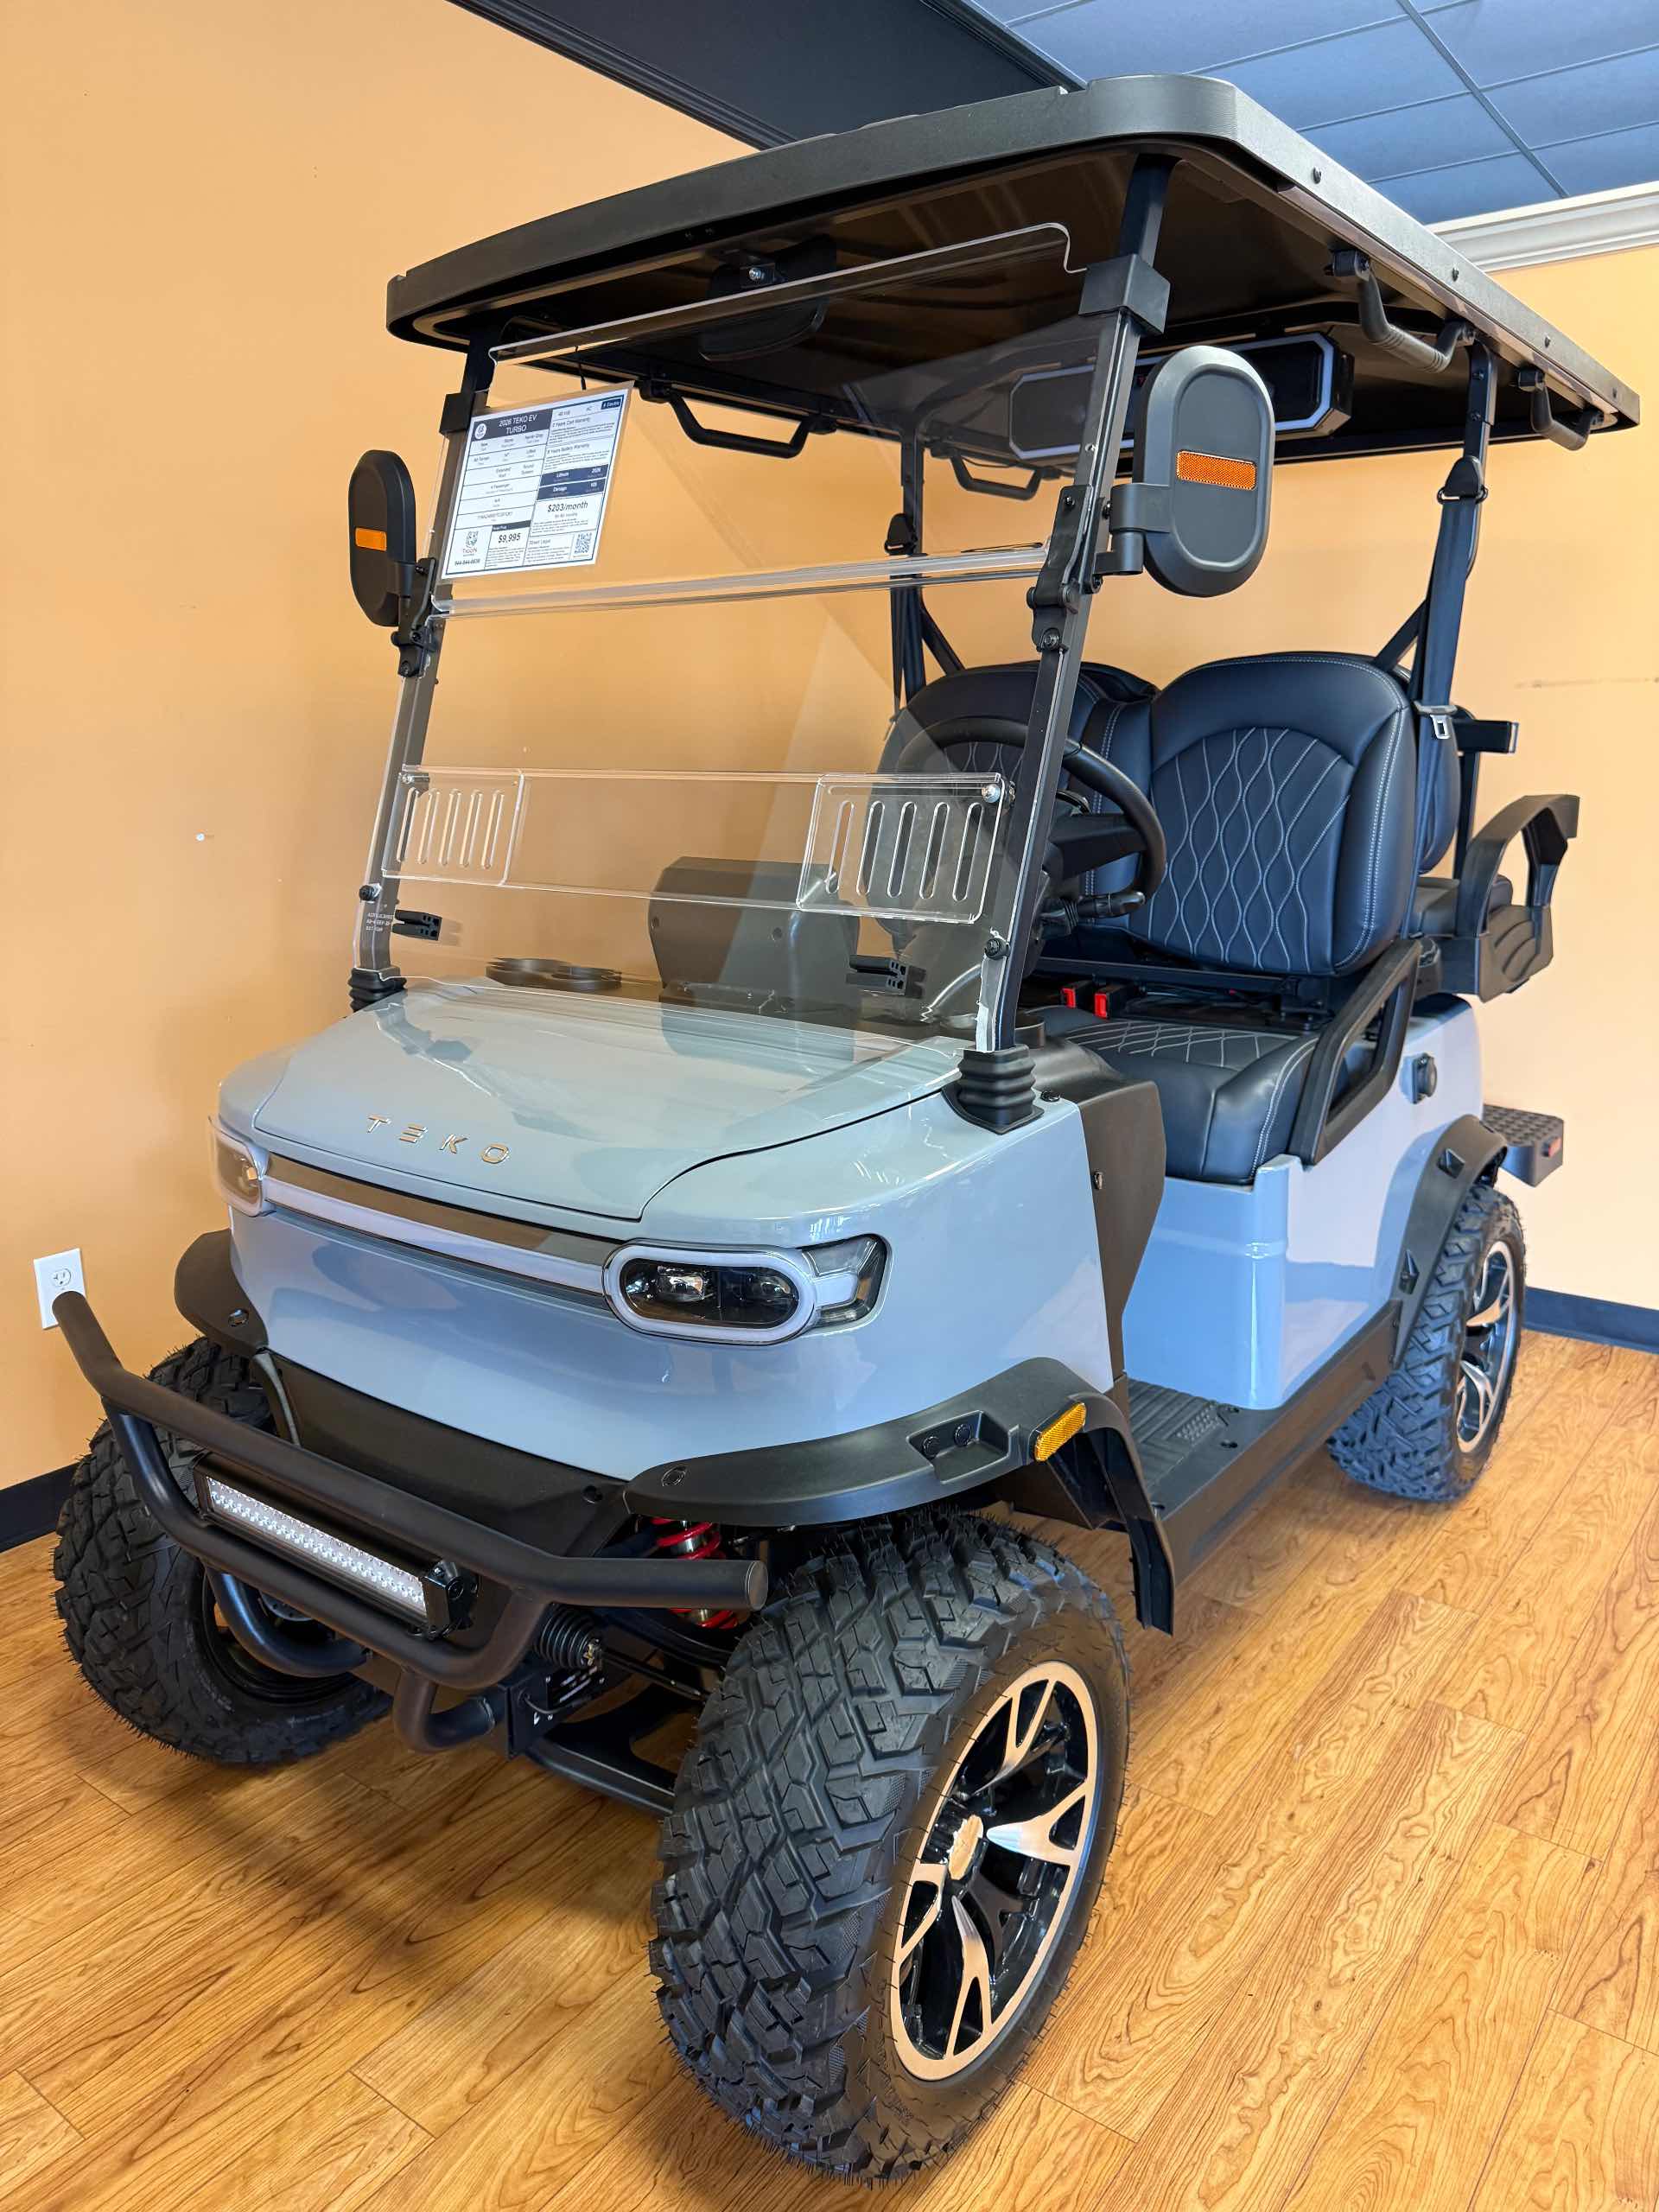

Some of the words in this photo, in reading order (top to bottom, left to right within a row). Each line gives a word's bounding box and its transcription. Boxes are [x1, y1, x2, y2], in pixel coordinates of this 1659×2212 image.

[512, 416, 528, 424] TEKO
[505, 424, 527, 435] TURBO
[547, 501, 588, 512] $203/month
[498, 532, 521, 543] $9,995
[367, 1114, 511, 1165] TEKO
